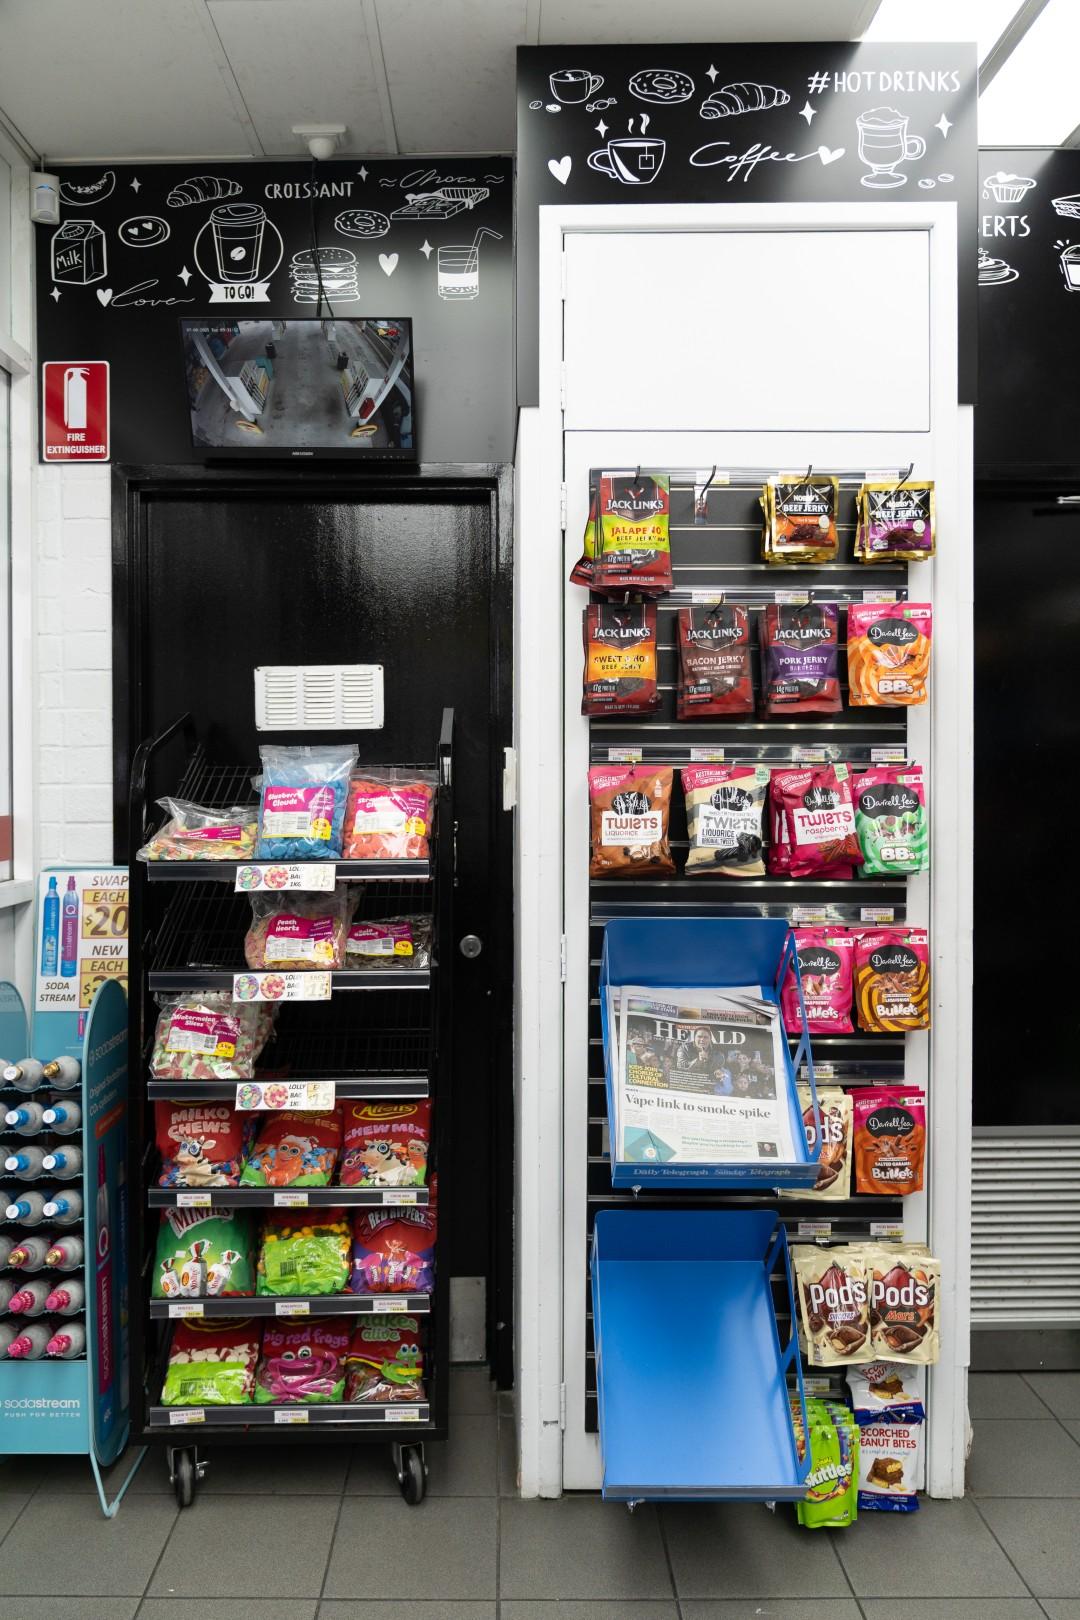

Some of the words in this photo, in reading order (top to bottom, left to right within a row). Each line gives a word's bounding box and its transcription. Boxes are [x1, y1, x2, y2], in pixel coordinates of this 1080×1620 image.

[689, 141, 821, 182] Coffee
[264, 180, 354, 200] CROISSANT
[977, 214, 1031, 238] ERTS
[55, 251, 83, 270] Milk
[223, 285, 238, 301] TO
[239, 284, 256, 300] GO!
[66, 432, 86, 442] FIRE
[46, 445, 106, 455] EXTINGUISHER
[605, 499, 634, 511] JACK
[782, 504, 804, 513] BEEF
[803, 504, 829, 513] JERKY
[592, 627, 620, 639] JACK
[687, 628, 713, 641] JACK
[773, 629, 800, 640] JACK
[870, 626, 901, 639] Darrell
[898, 628, 917, 641] Lea
[686, 657, 717, 668] BACON
[718, 655, 745, 665] JERKY
[779, 656, 802, 666] PORK
[802, 655, 828, 664] JERKY
[877, 679, 914, 695] BB's
[267, 791, 304, 801] Blueberr
[804, 794, 827, 806] Daell
[862, 795, 900, 810] Darrell
[898, 794, 918, 810] Lea
[702, 829, 735, 838] LIQUORICE
[805, 825, 849, 836] raspberry
[879, 847, 917, 863] BB's
[91, 875, 129, 887] SWAP
[93, 891, 126, 903] EACH
[85, 905, 129, 937] $20
[275, 925, 300, 933] Hearts
[91, 945, 124, 956] NEW
[90, 960, 123, 972] EACH
[822, 957, 840, 970] Lea
[871, 954, 902, 968] Darrell
[899, 955, 917, 968] Lea
[44, 982, 70, 991] SODA
[39, 993, 76, 1003] STREAM
[796, 1005, 839, 1019] Bullets
[876, 1003, 919, 1017] Bullets
[172, 1012, 216, 1023] Watermelon
[184, 1020, 204, 1028] Slices
[653, 1019, 746, 1045] HEALD
[628, 1073, 660, 1083] CULTURAL
[628, 1077, 669, 1089] CONNECTION
[625, 1093, 655, 1108] Vape
[656, 1097, 681, 1110] link
[683, 1101, 695, 1112] to
[697, 1103, 738, 1116] smoke
[738, 1106, 772, 1120] spike
[171, 1107, 231, 1125] MILKO
[868, 1116, 901, 1131] Darrell
[898, 1115, 913, 1131] Lea
[167, 1121, 232, 1142] CHEWS
[344, 1124, 390, 1142] CHEW
[391, 1123, 427, 1138] MIX
[805, 1116, 844, 1145] ods
[871, 1166, 914, 1181] Bullets
[367, 1208, 388, 1230] RED
[809, 1277, 867, 1314] Pods
[871, 1278, 929, 1310] Pods
[884, 1310, 916, 1321] Mars
[357, 1314, 419, 1334] nakes
[263, 1330, 283, 1346] big
[286, 1327, 312, 1345] red
[312, 1327, 349, 1349] frogs
[360, 1321, 401, 1342] alive
[4, 1398, 80, 1410] sodastream
[860, 1427, 910, 1439] SCORCHED
[859, 1437, 893, 1448] EANUT
[892, 1438, 917, 1449] BITES
